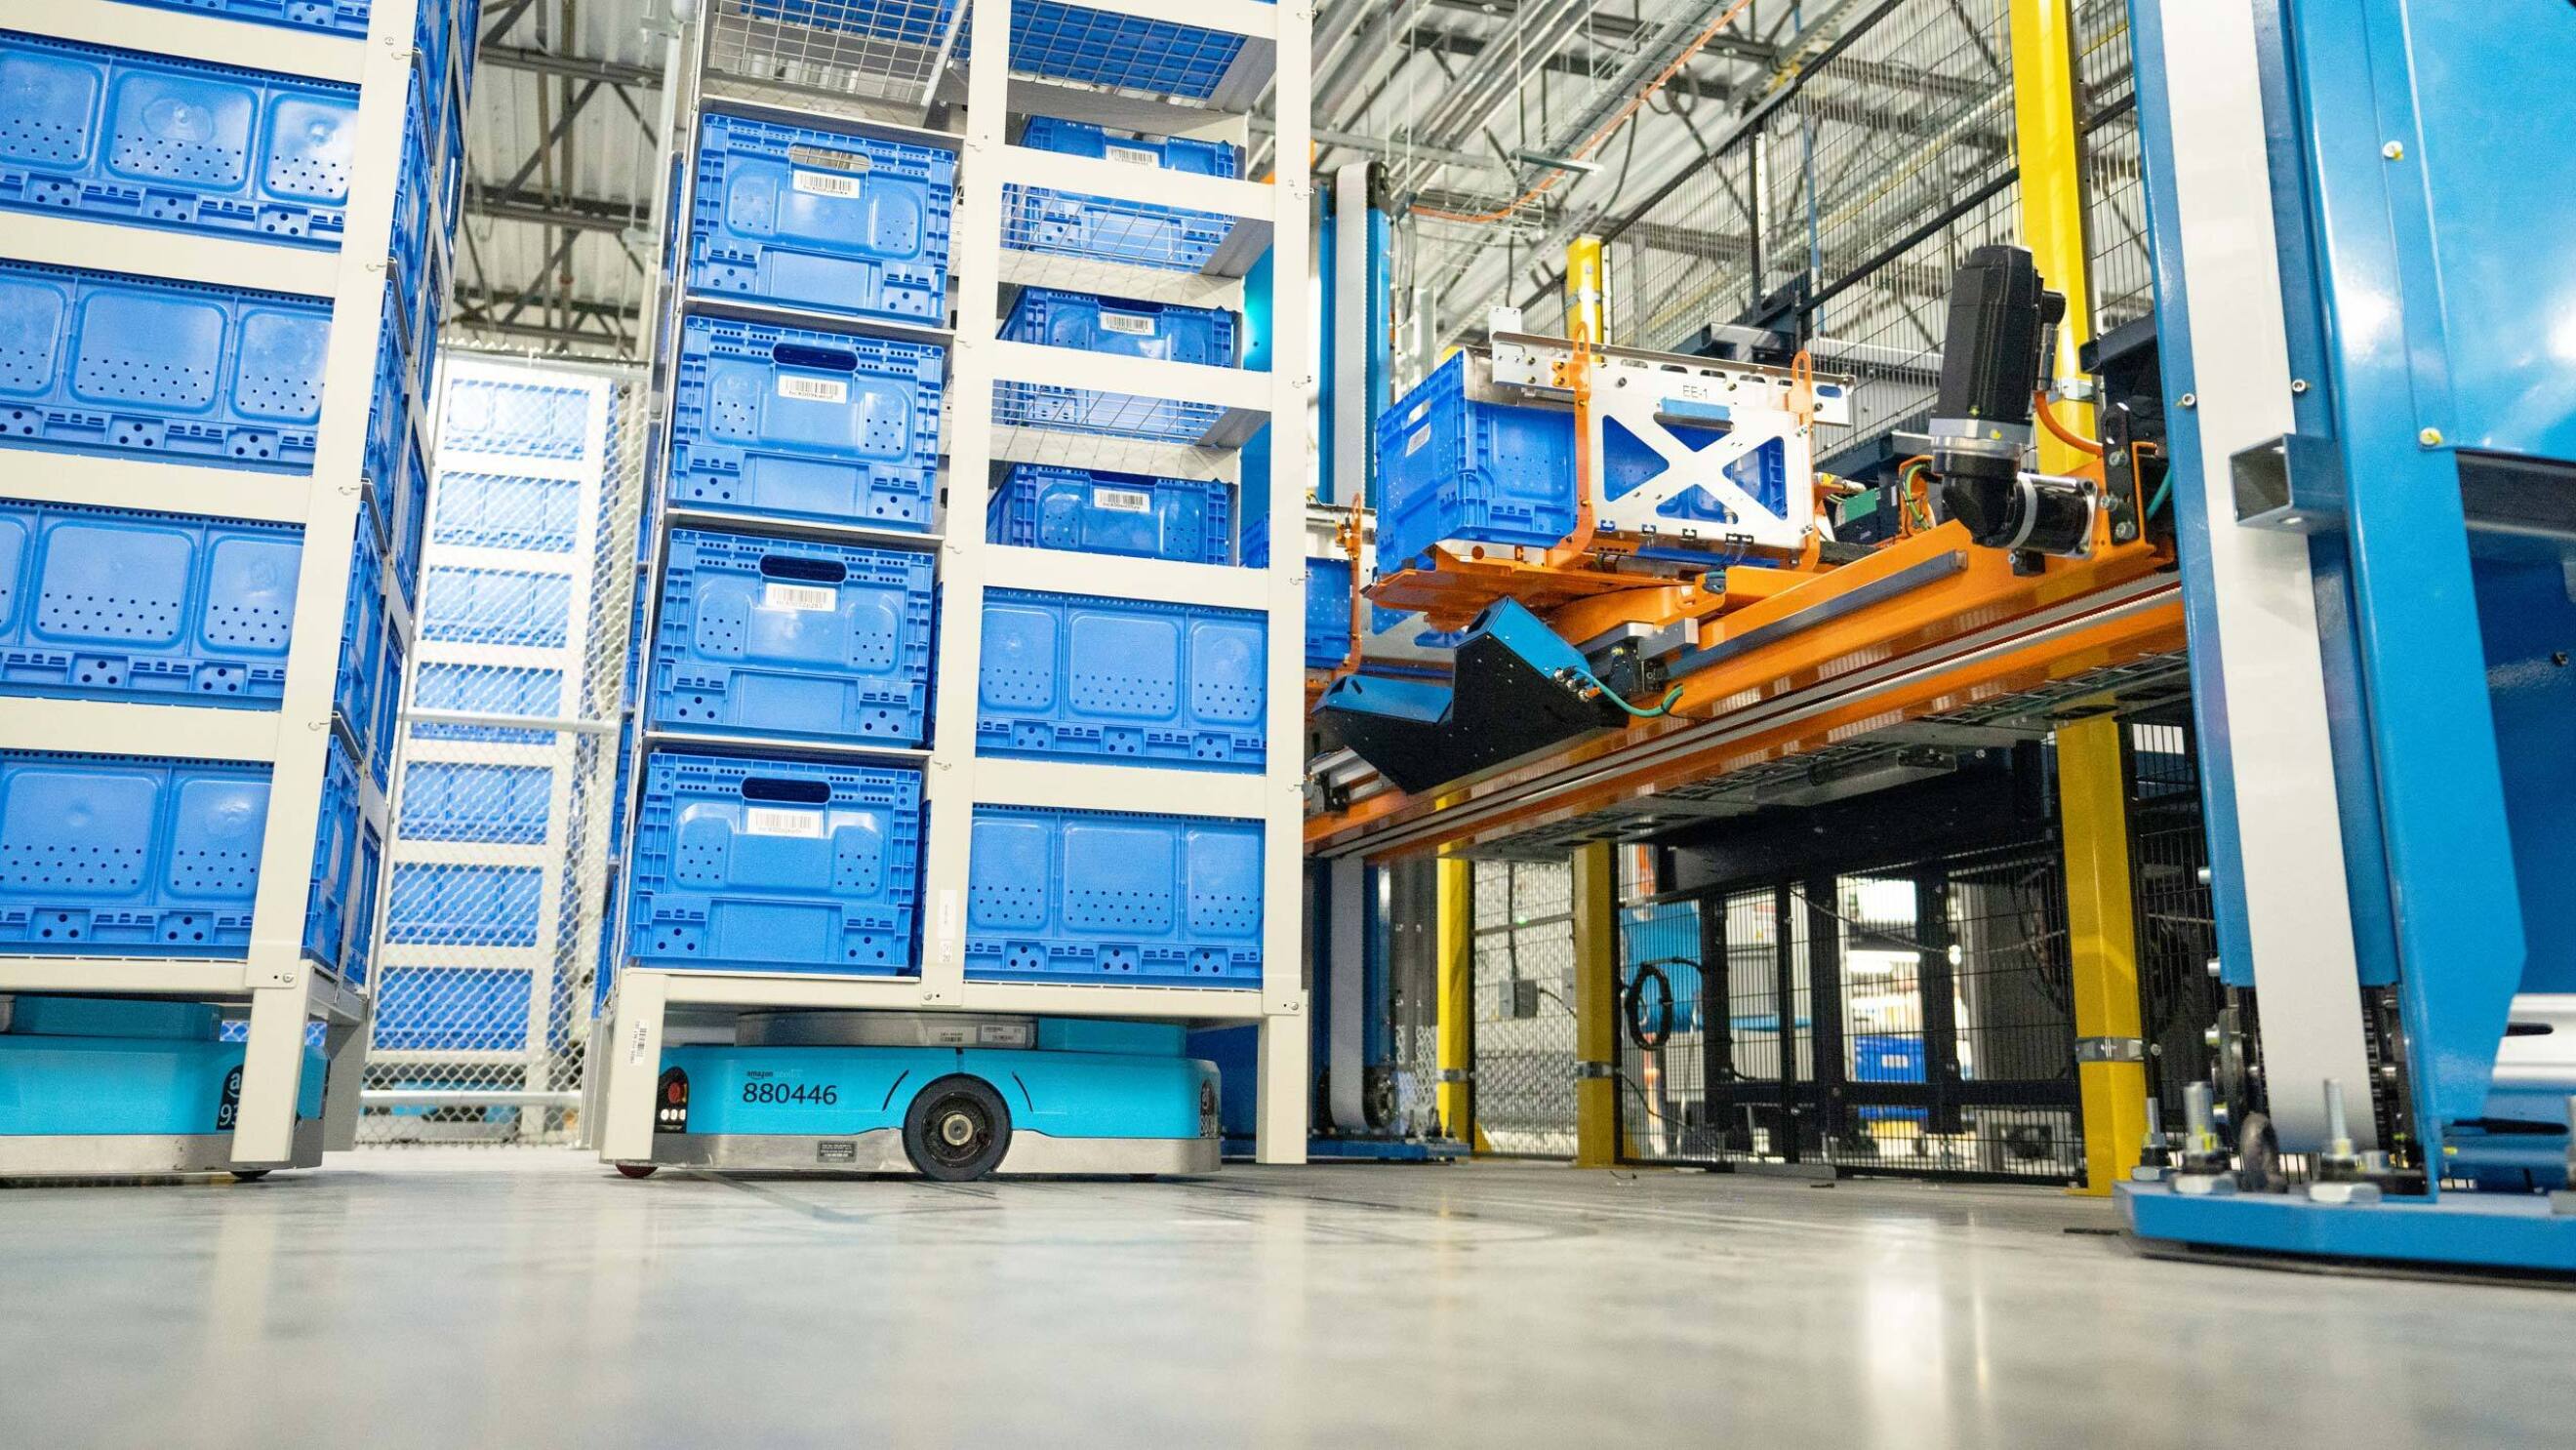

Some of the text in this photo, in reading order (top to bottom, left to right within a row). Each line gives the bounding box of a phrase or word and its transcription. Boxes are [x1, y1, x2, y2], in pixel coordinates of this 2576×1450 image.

[1682, 385, 1708, 399] EE-1
[746, 1070, 774, 1079] amazon
[742, 1082, 838, 1106] 880446
